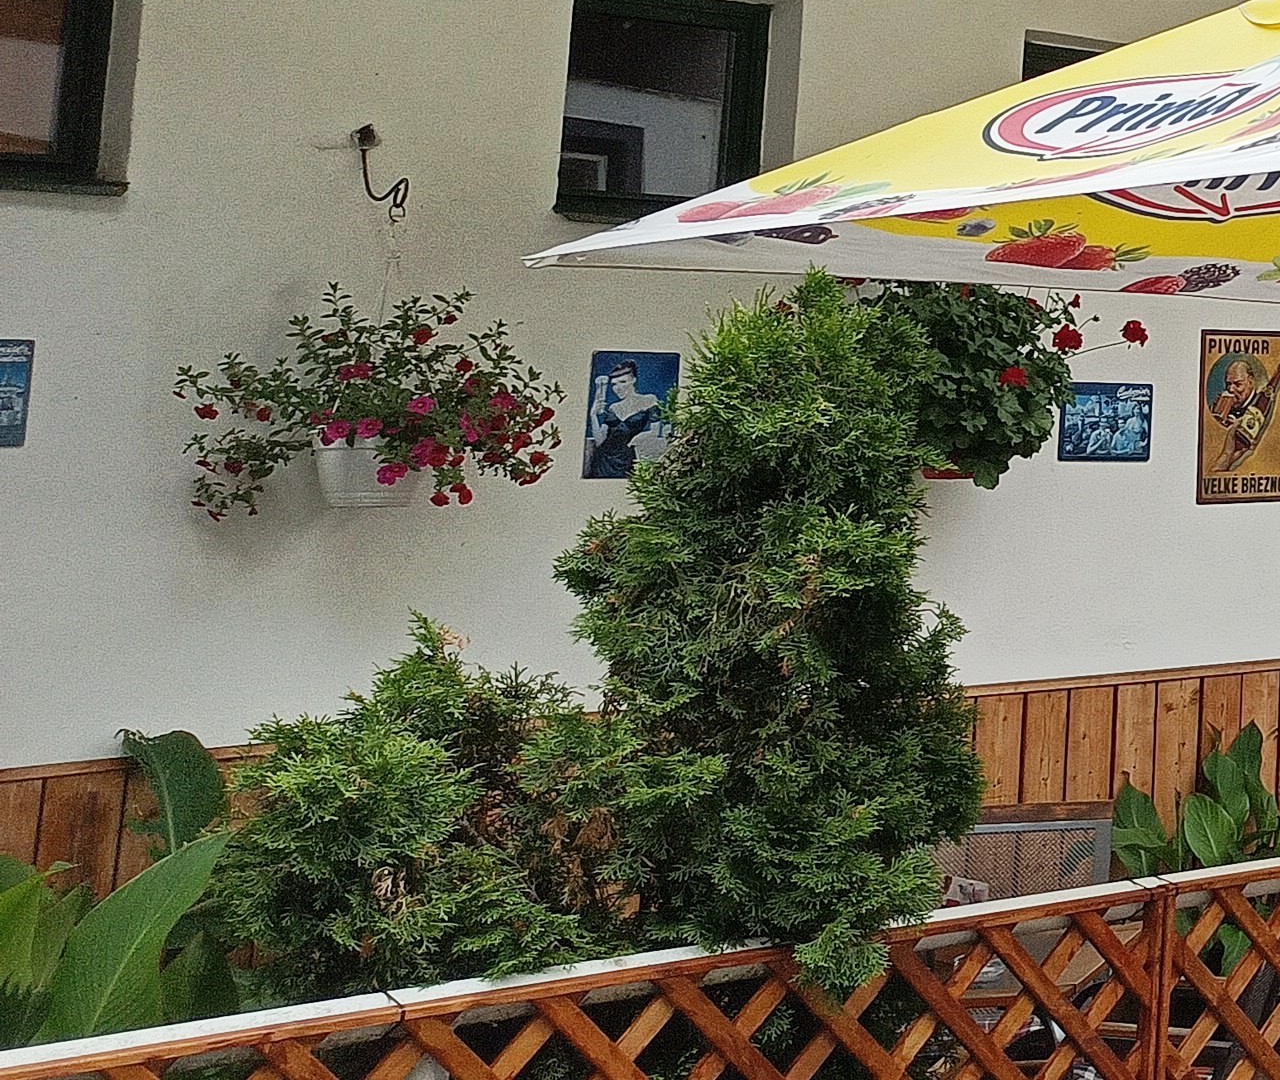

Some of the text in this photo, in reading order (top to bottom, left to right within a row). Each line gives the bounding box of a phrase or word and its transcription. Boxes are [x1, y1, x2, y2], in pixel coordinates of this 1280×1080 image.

[1034, 83, 1261, 134] Prima
[1208, 338, 1269, 355] PIVOVAR
[1203, 474, 1238, 495] VELKÉ
